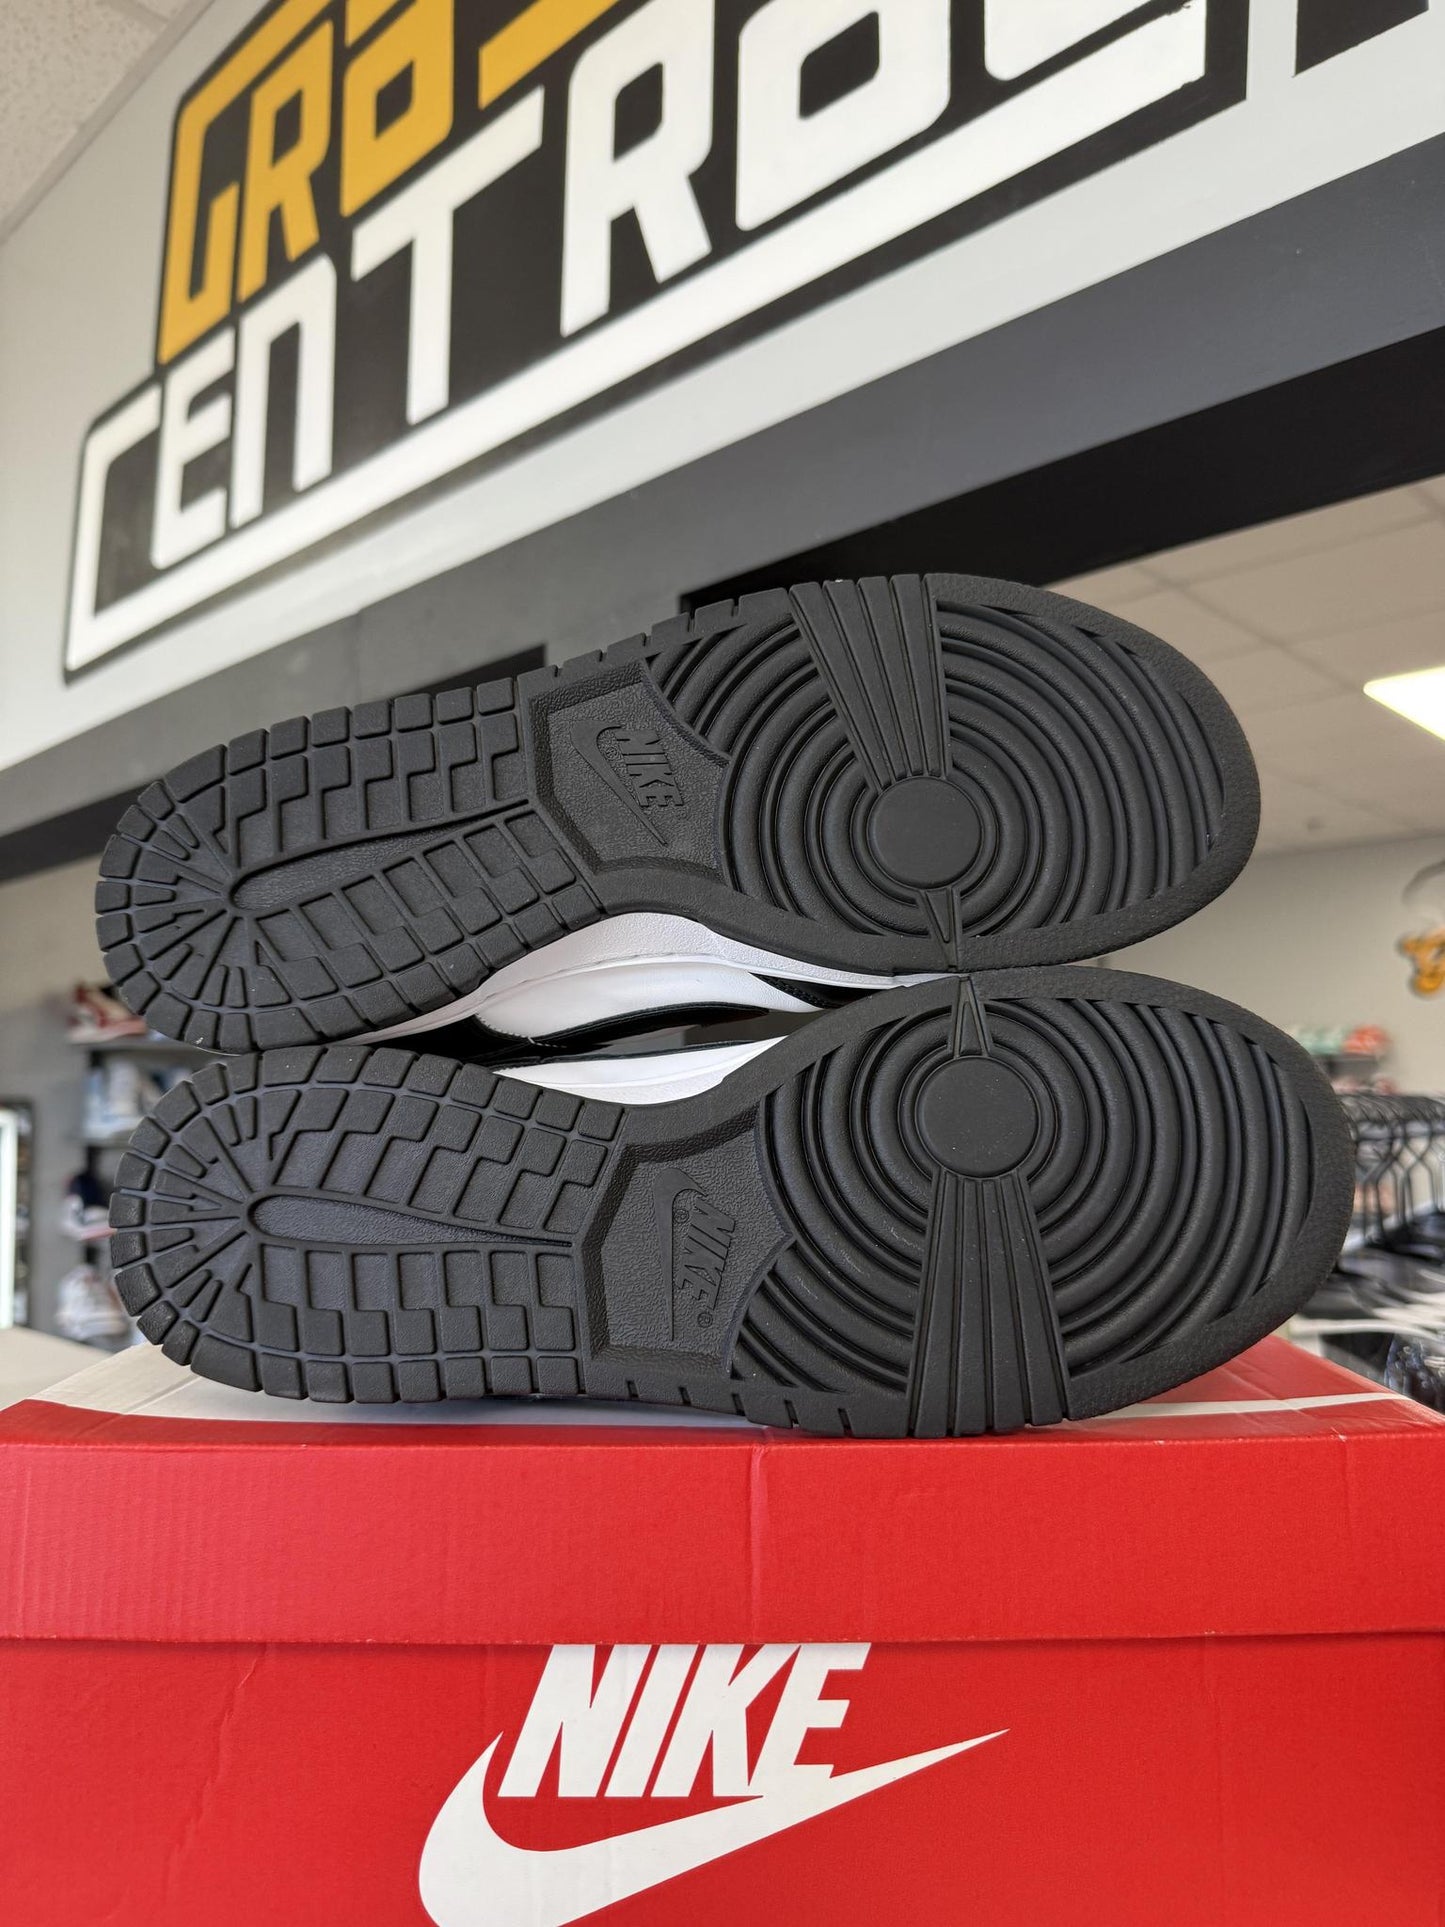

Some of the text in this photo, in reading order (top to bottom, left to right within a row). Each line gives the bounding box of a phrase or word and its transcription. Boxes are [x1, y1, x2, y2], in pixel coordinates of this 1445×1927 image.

[613, 728, 685, 808] NIKE
[673, 1198, 736, 1312] NIKE
[497, 1643, 871, 1798] NIKE
